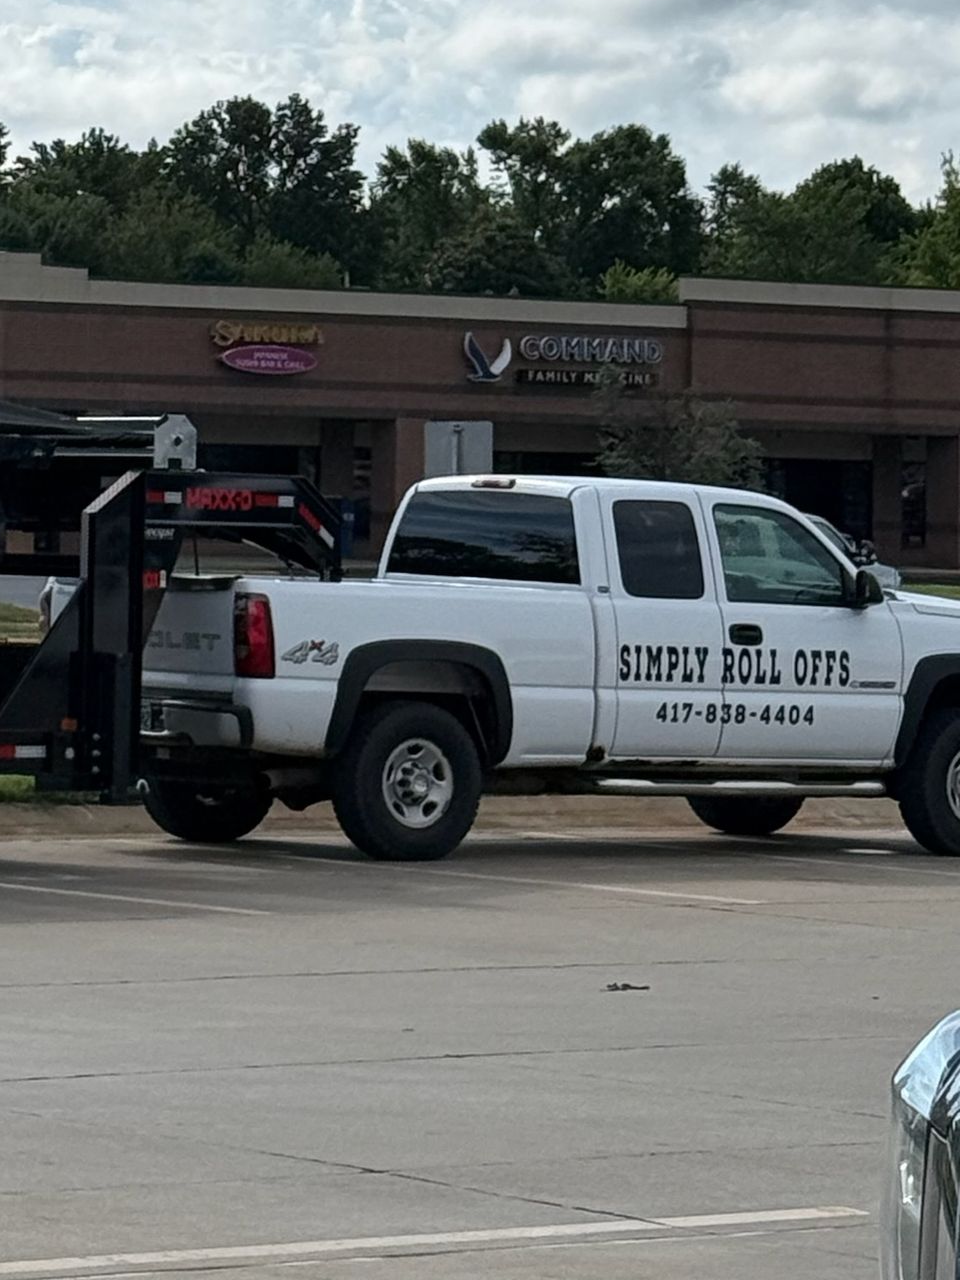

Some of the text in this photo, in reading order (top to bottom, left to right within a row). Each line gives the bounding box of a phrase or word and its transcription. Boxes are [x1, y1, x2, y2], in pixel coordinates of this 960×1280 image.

[520, 335, 663, 364] COMMAND
[528, 370, 651, 385] FAMILY MECINE
[619, 644, 851, 687] SIMPLY ROLL OFFS
[656, 702, 815, 726] 417-838-4404
